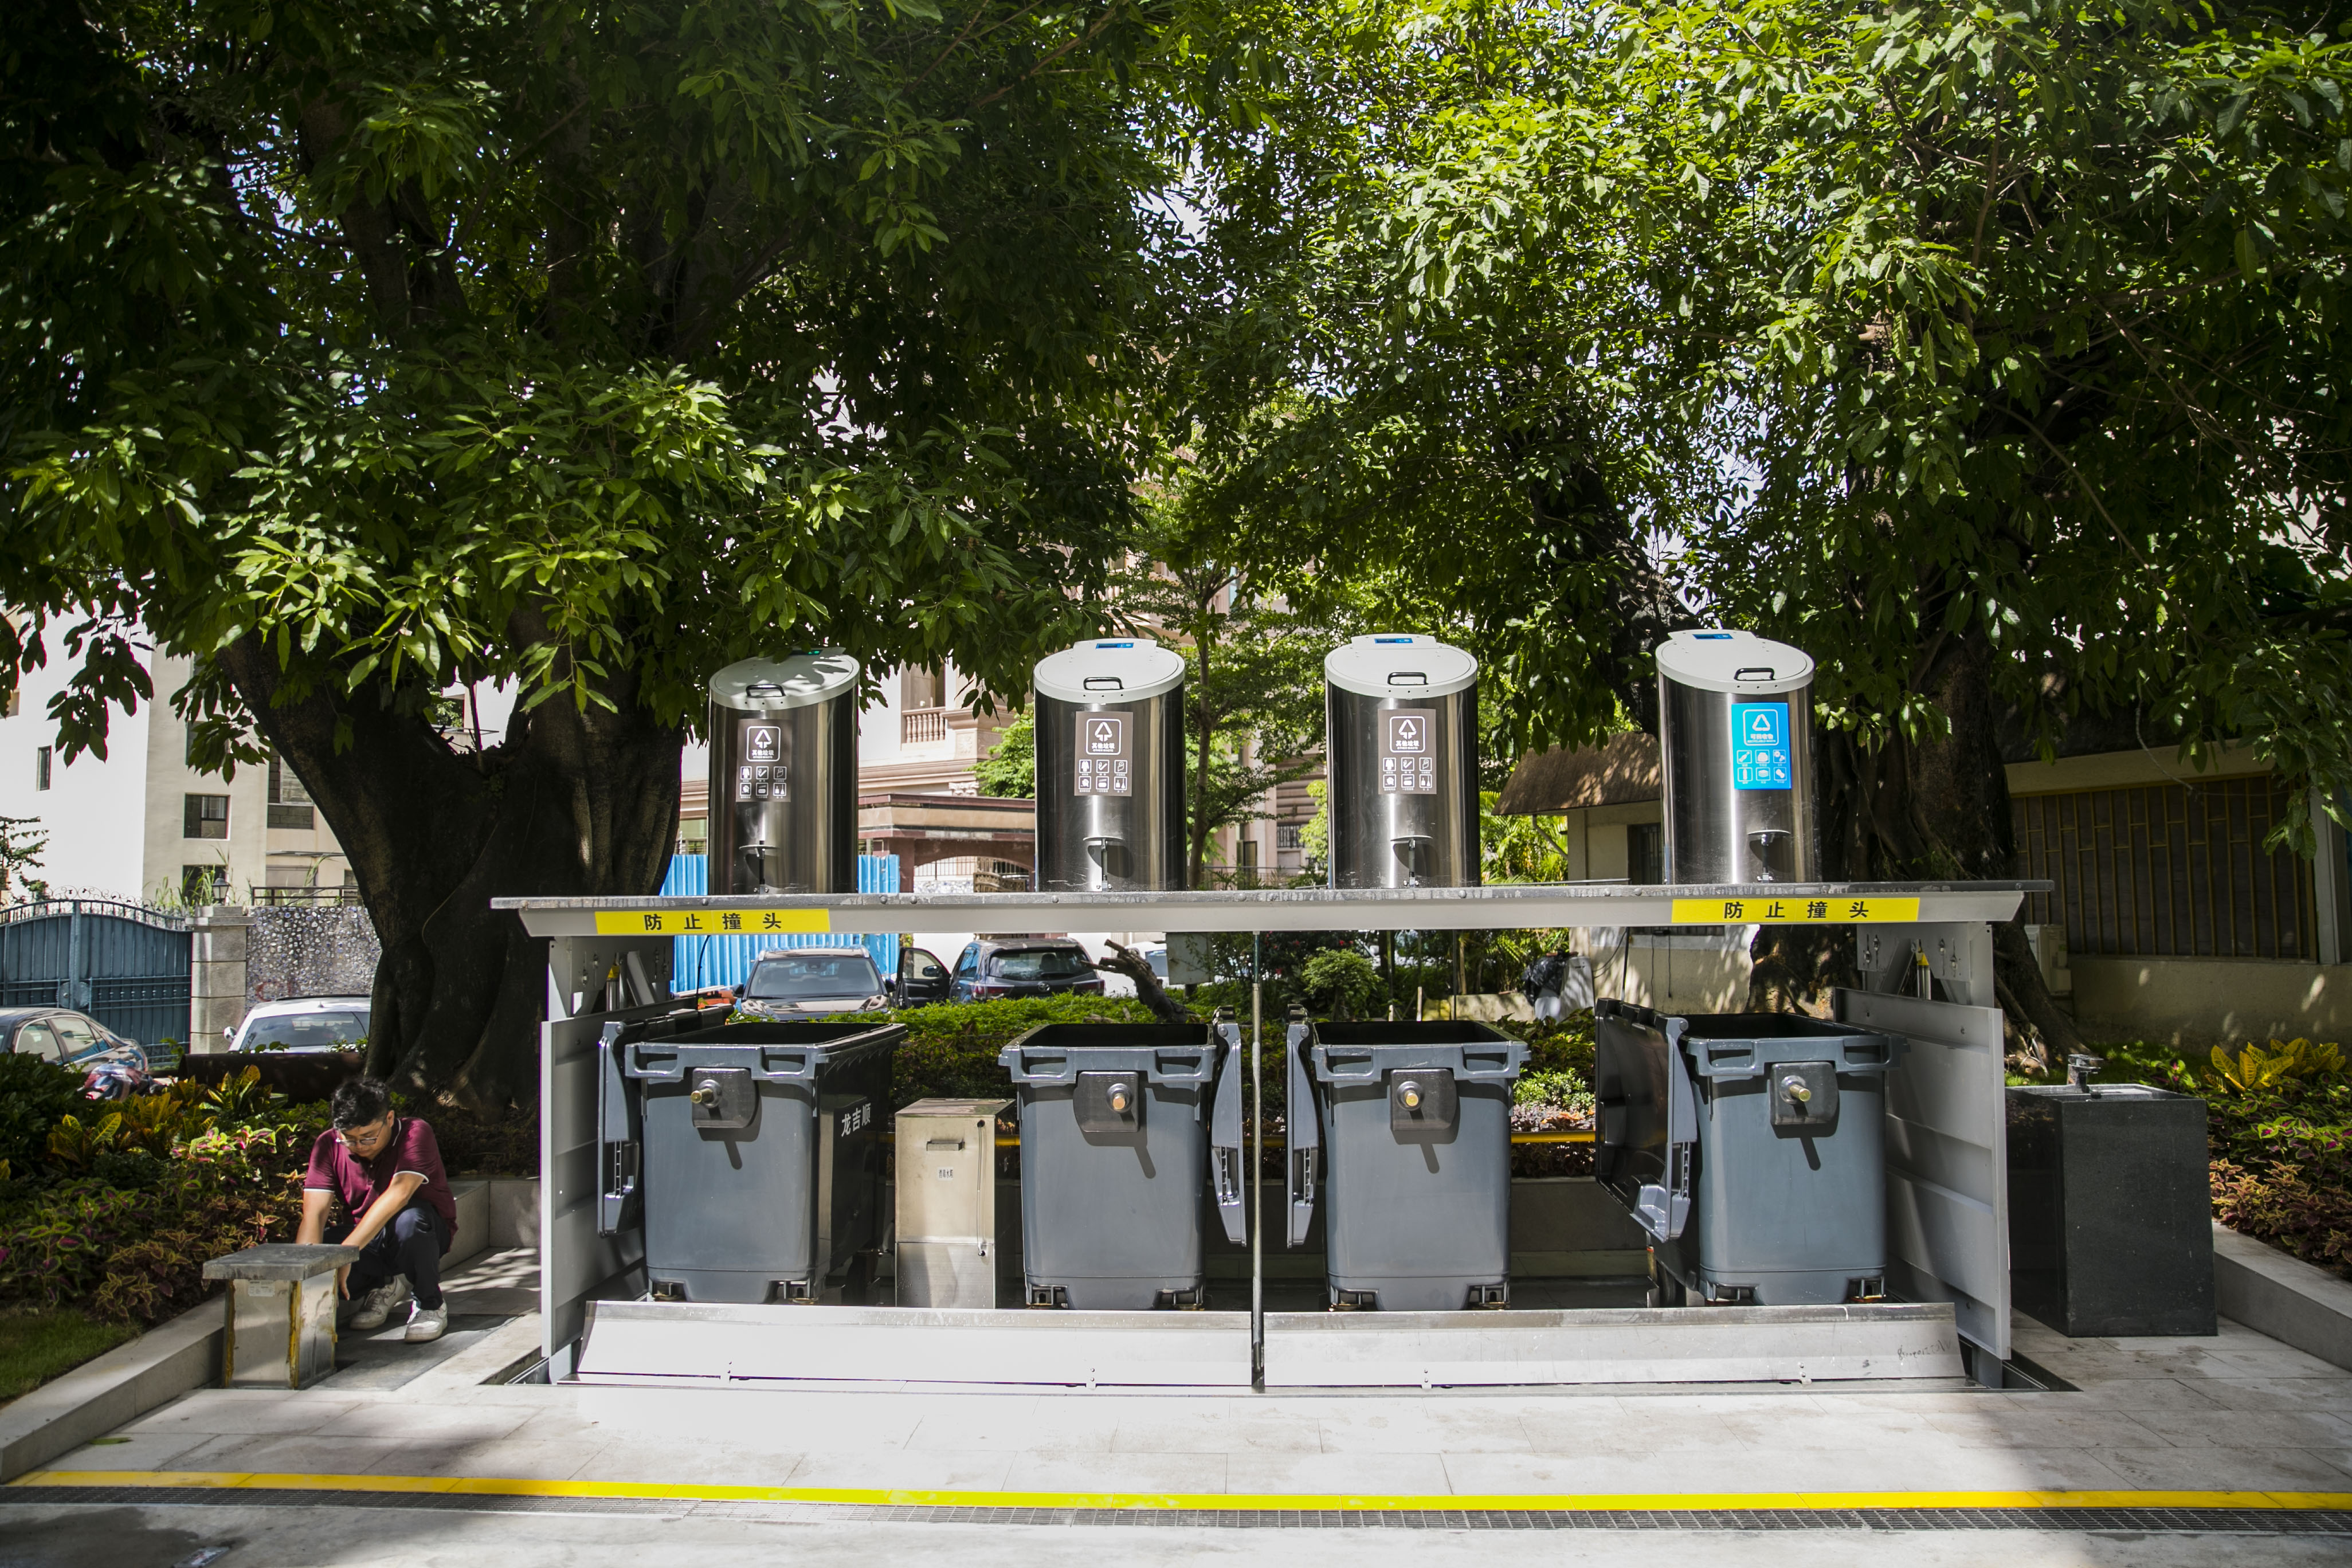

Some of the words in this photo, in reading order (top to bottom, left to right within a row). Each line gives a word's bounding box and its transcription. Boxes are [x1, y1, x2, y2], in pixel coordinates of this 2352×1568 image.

[1724, 901, 1869, 919] 防止撞头
[644, 912, 782, 931] 防止撞头
[841, 1103, 871, 1138] 龙吉顺
